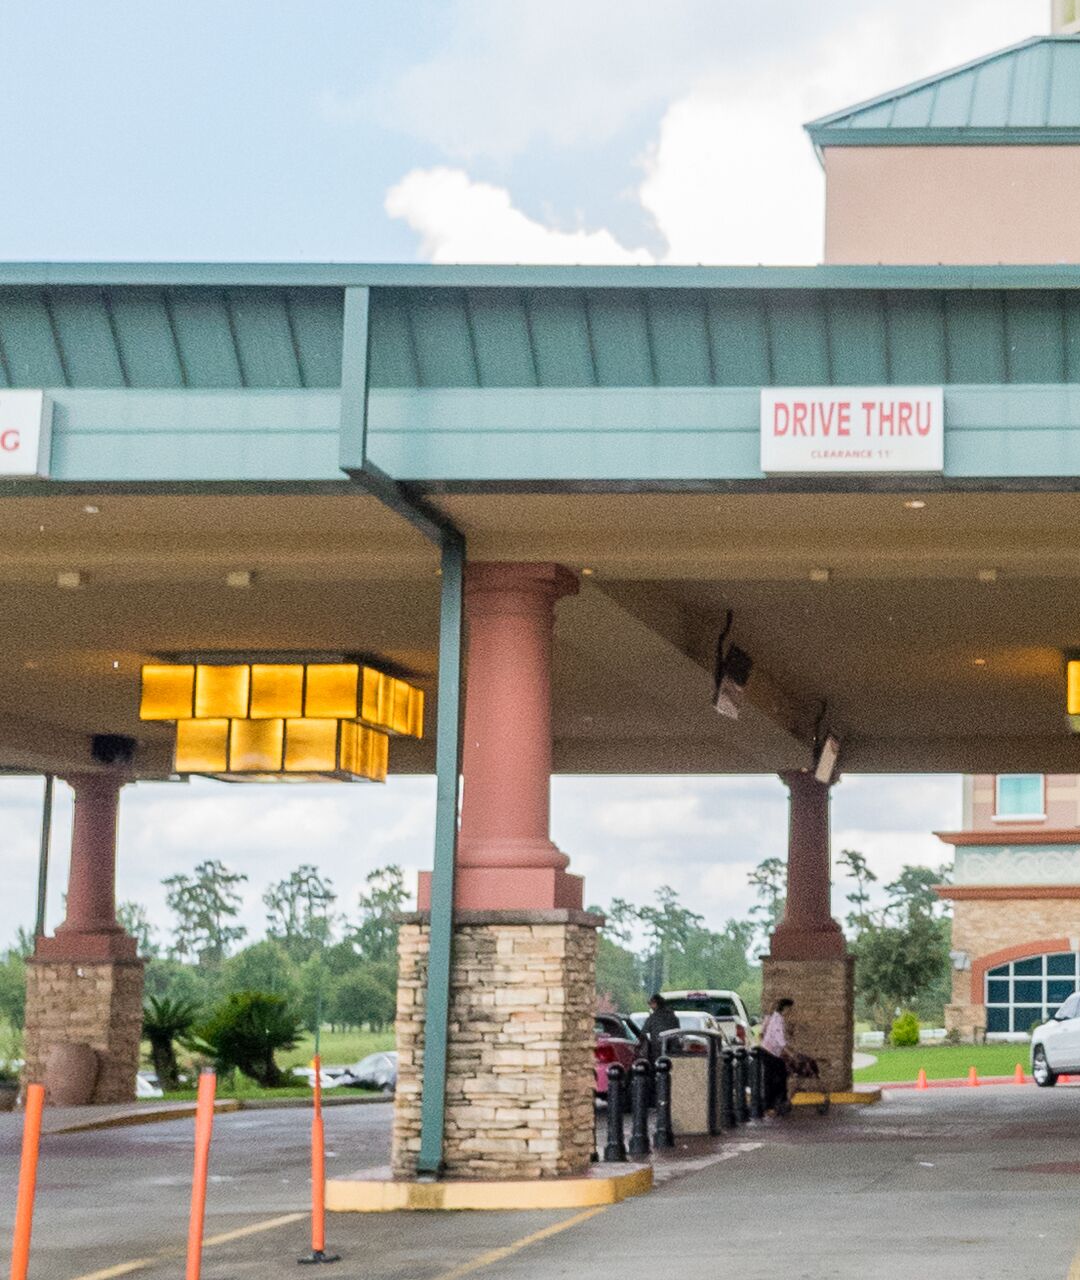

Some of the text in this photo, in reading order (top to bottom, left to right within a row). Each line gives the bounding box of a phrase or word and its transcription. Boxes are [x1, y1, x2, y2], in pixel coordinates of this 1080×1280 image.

[774, 402, 931, 437] DRIVE THRU
[811, 450, 872, 459] CLEARANCE
